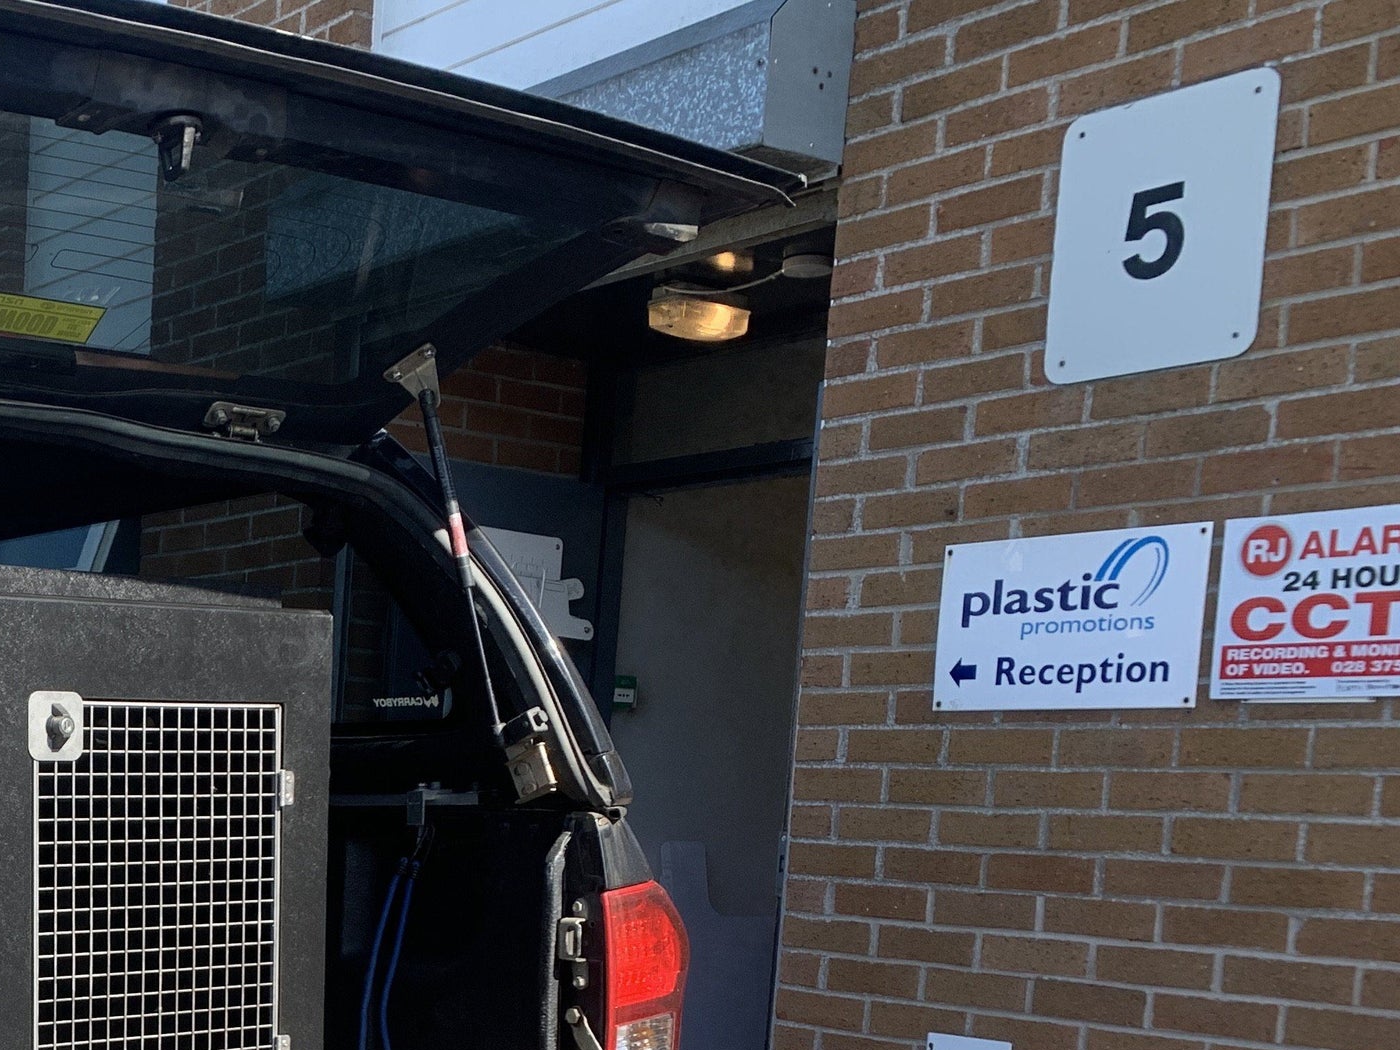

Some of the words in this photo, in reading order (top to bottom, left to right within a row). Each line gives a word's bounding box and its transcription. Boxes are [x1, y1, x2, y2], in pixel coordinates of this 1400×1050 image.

[1122, 180, 1186, 281] 5
[1246, 537, 1288, 563] RJ
[1300, 524, 1400, 560] ALAR
[1282, 570, 1320, 592] 24
[1330, 564, 1400, 590] HOU
[961, 572, 1120, 628] plastic
[1230, 591, 1400, 642] CCT
[1020, 614, 1155, 640] promotions
[1225, 663, 1249, 676] OF
[1252, 662, 1310, 675] VIDEO.
[1330, 660, 1366, 673] 028
[1227, 646, 1329, 660] RECORDING
[1332, 645, 1346, 658] &
[995, 652, 1170, 694] Reception
